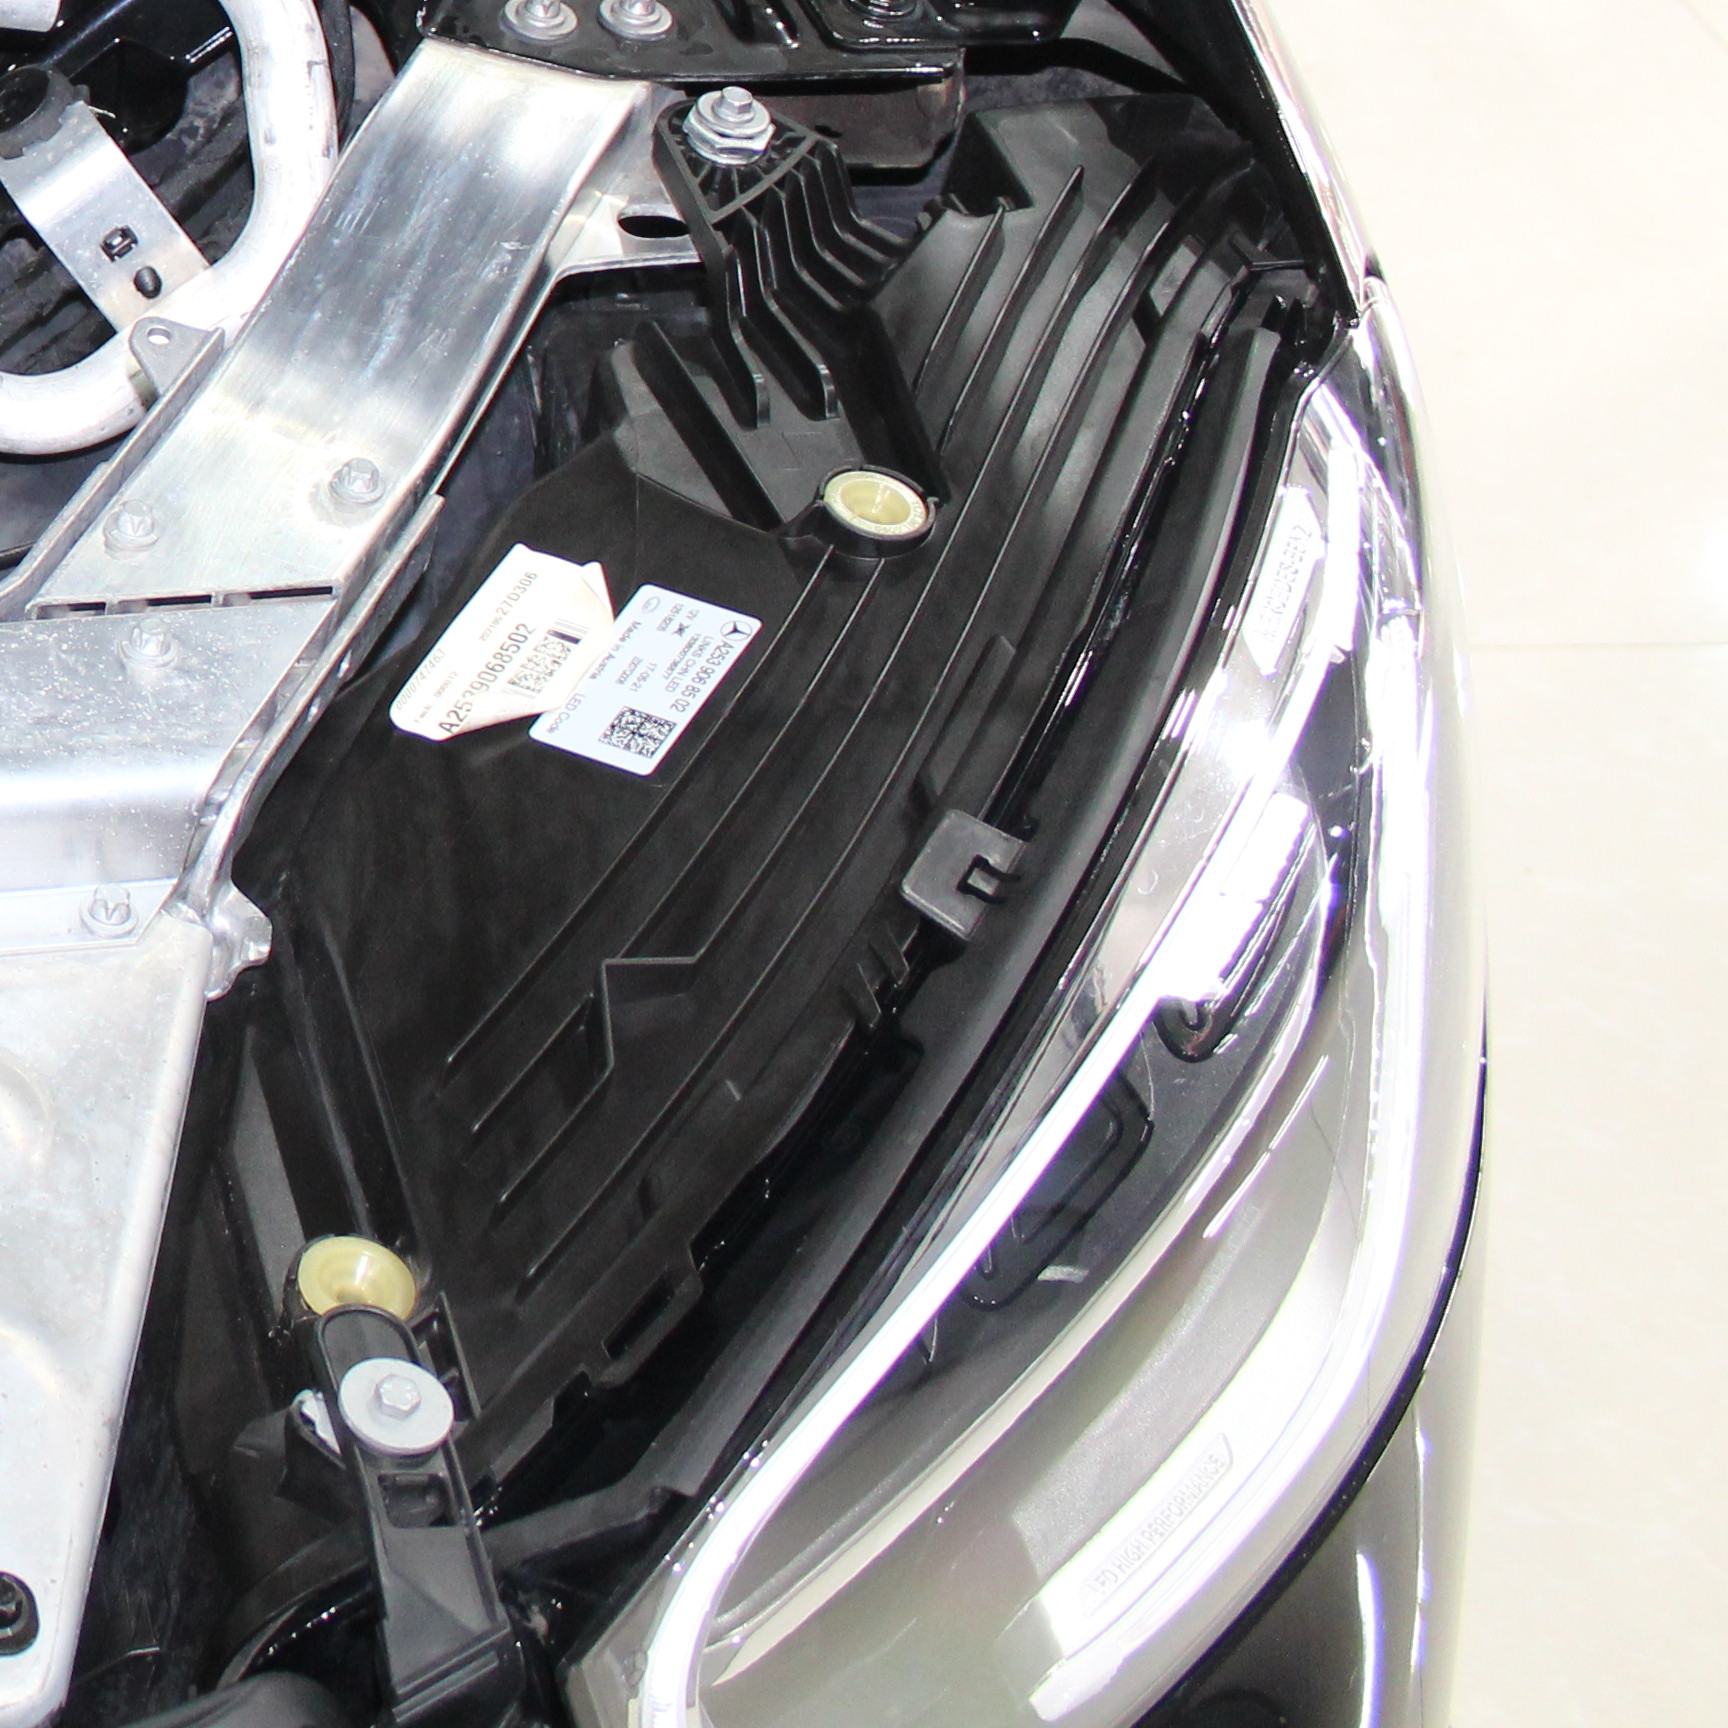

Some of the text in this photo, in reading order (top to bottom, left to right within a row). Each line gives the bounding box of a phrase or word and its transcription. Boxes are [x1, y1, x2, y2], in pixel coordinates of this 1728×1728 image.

[588, 620, 642, 681] Made in Austria
[690, 634, 714, 658] LINKS
[663, 675, 683, 693] LED
[668, 639, 736, 713] A253 906 85 02
[544, 692, 586, 735] LED Code
[1114, 1536, 1151, 1575] HIGH
[1143, 1453, 1228, 1549] PERFORMANCE
